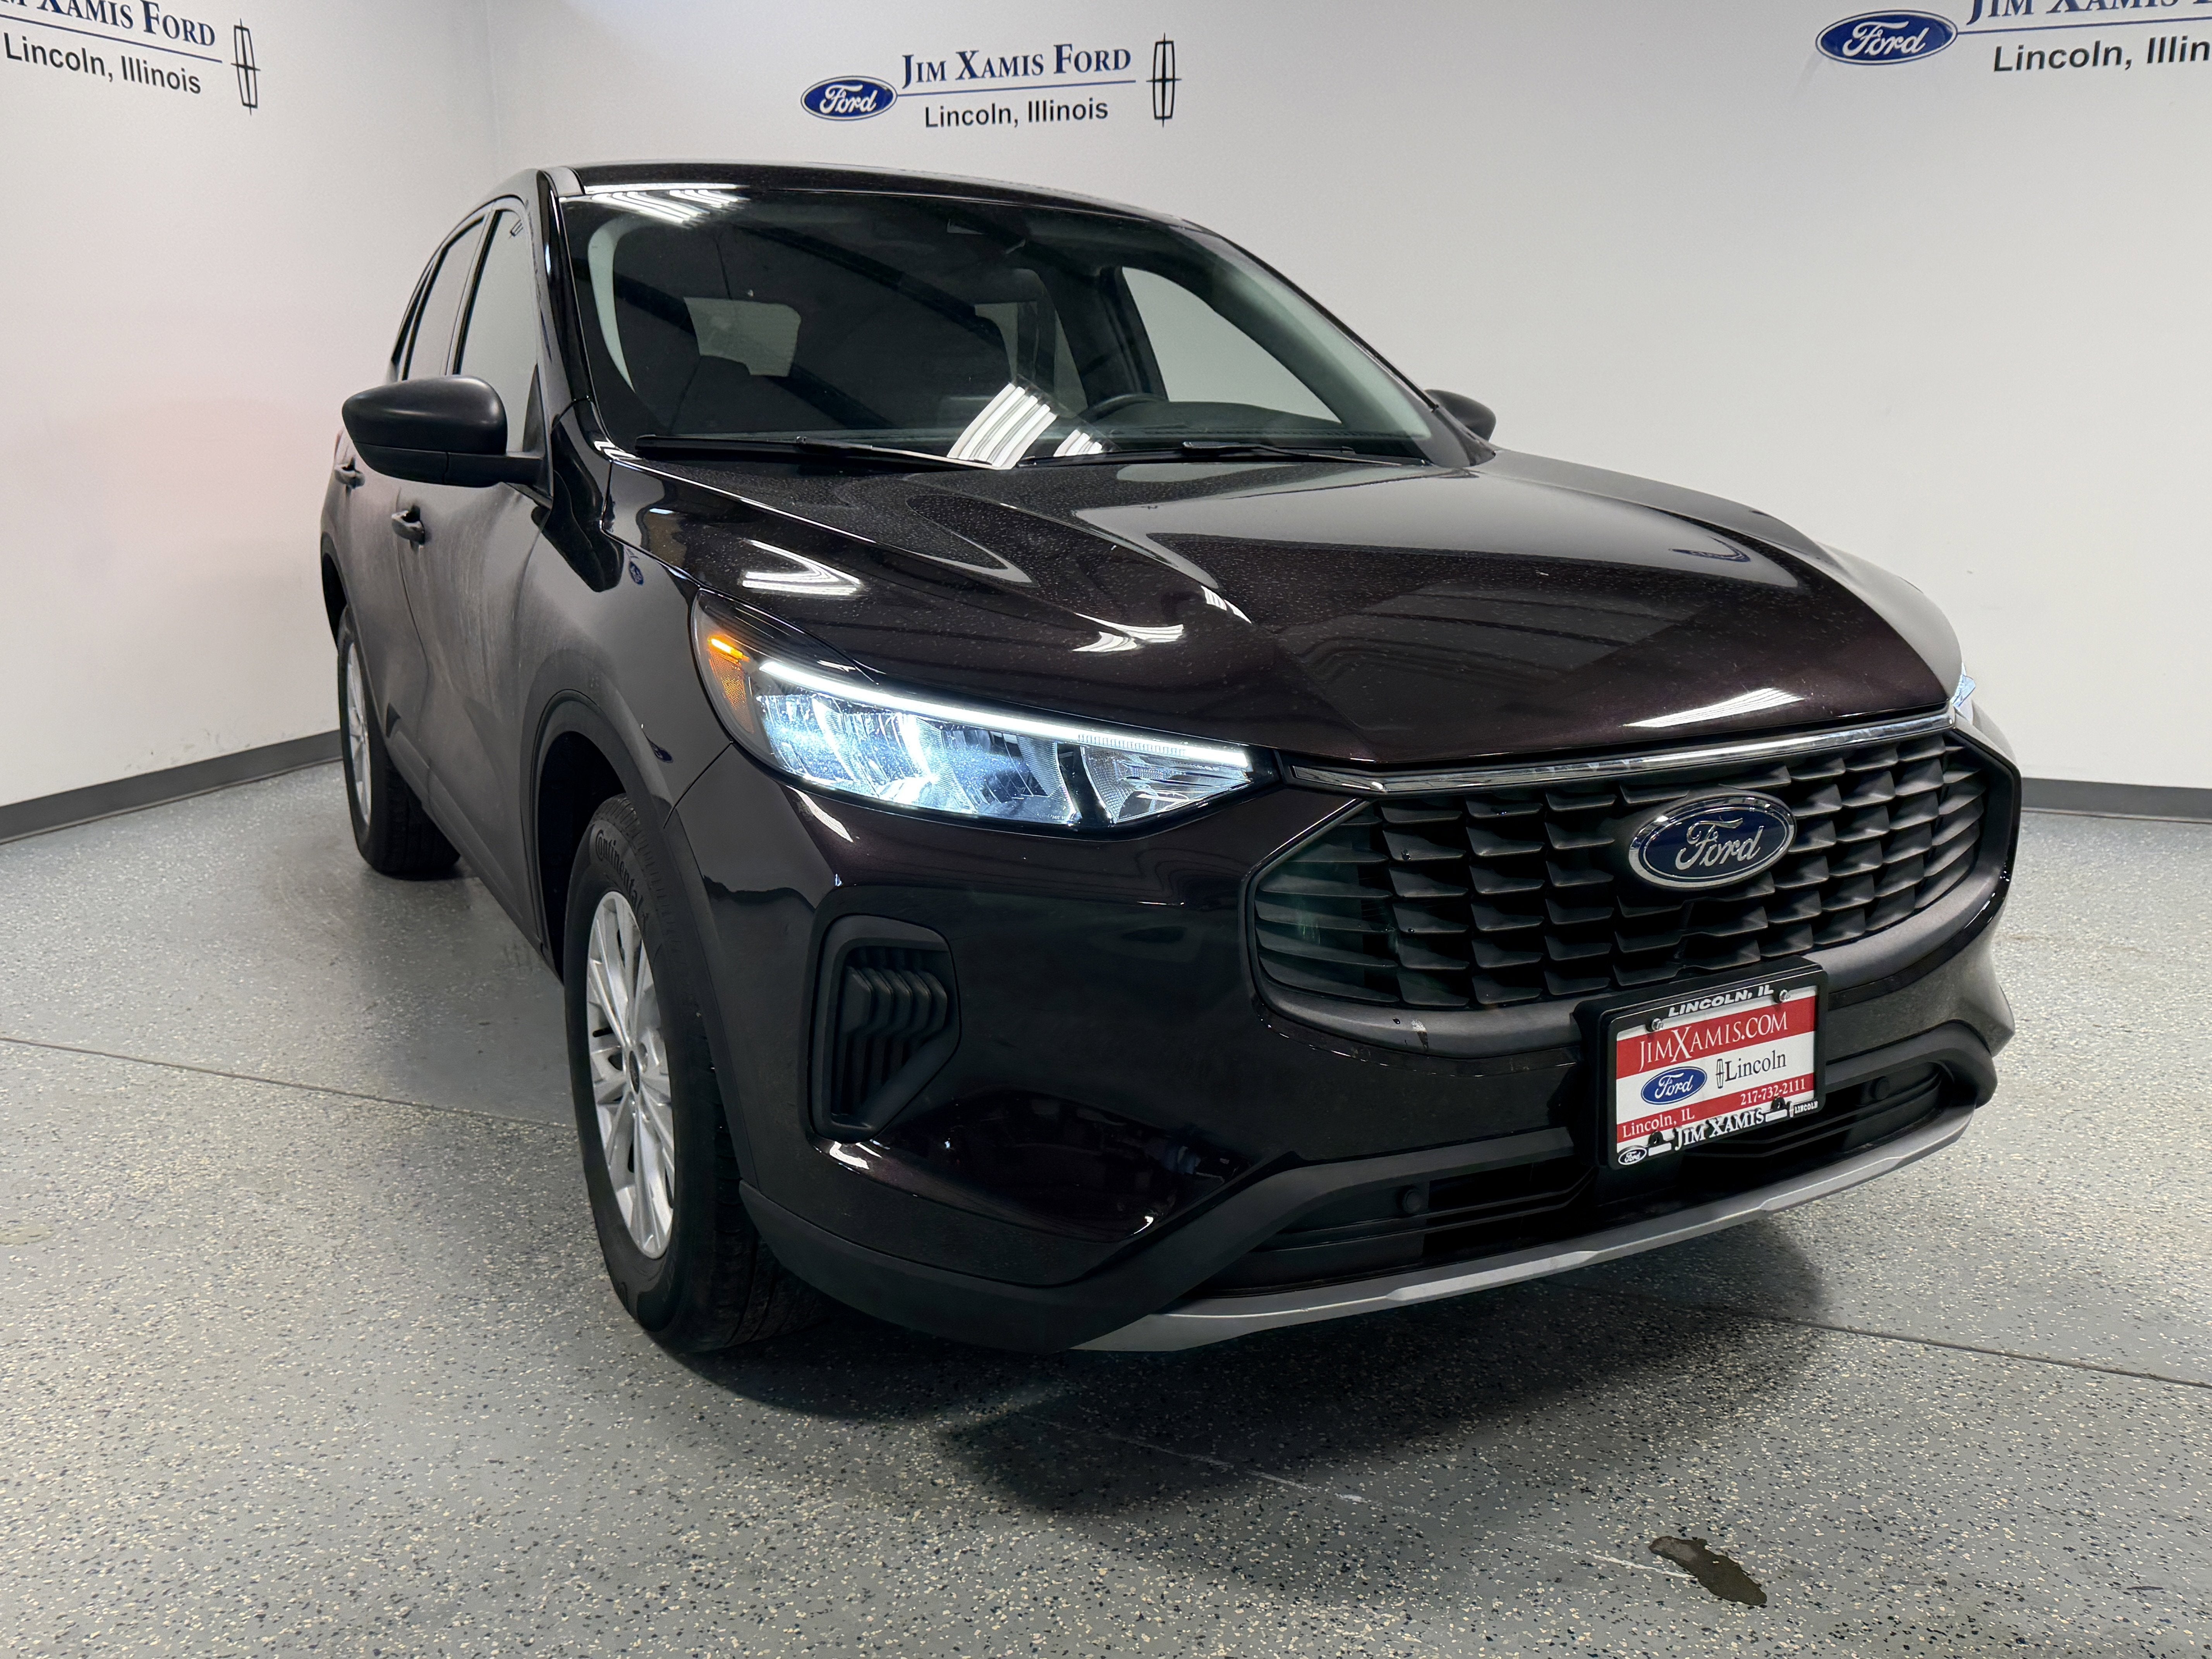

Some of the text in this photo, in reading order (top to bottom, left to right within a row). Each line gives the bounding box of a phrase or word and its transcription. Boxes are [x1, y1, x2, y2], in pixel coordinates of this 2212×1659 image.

[140, 0, 215, 46] FORD
[1842, 21, 1929, 56] Ford
[3, 33, 201, 94] Lincoln, Illinois
[902, 43, 1131, 89] JIM XAMIS FORD
[1994, 41, 2132, 72] Lincoln,
[819, 84, 877, 114] Ford
[925, 98, 1109, 128] Lincoln, Illinois
[1675, 818, 1764, 870] Ford
[595, 829, 644, 915] Continental
[1668, 984, 1774, 1017] LINCOLN, IL
[1638, 1011, 1788, 1072] JIMXAMIS.COM
[1724, 1050, 1787, 1082] Lincoln
[1655, 1073, 1693, 1099] Ford
[1740, 1078, 1806, 1106] 217-732-2111
[1623, 1108, 1695, 1138] Lincoln, IL
[1794, 1100, 1819, 1114] LINCOLN
[1675, 1110, 1765, 1151] JIM XAMIS
[1625, 1151, 1641, 1163] Ford
